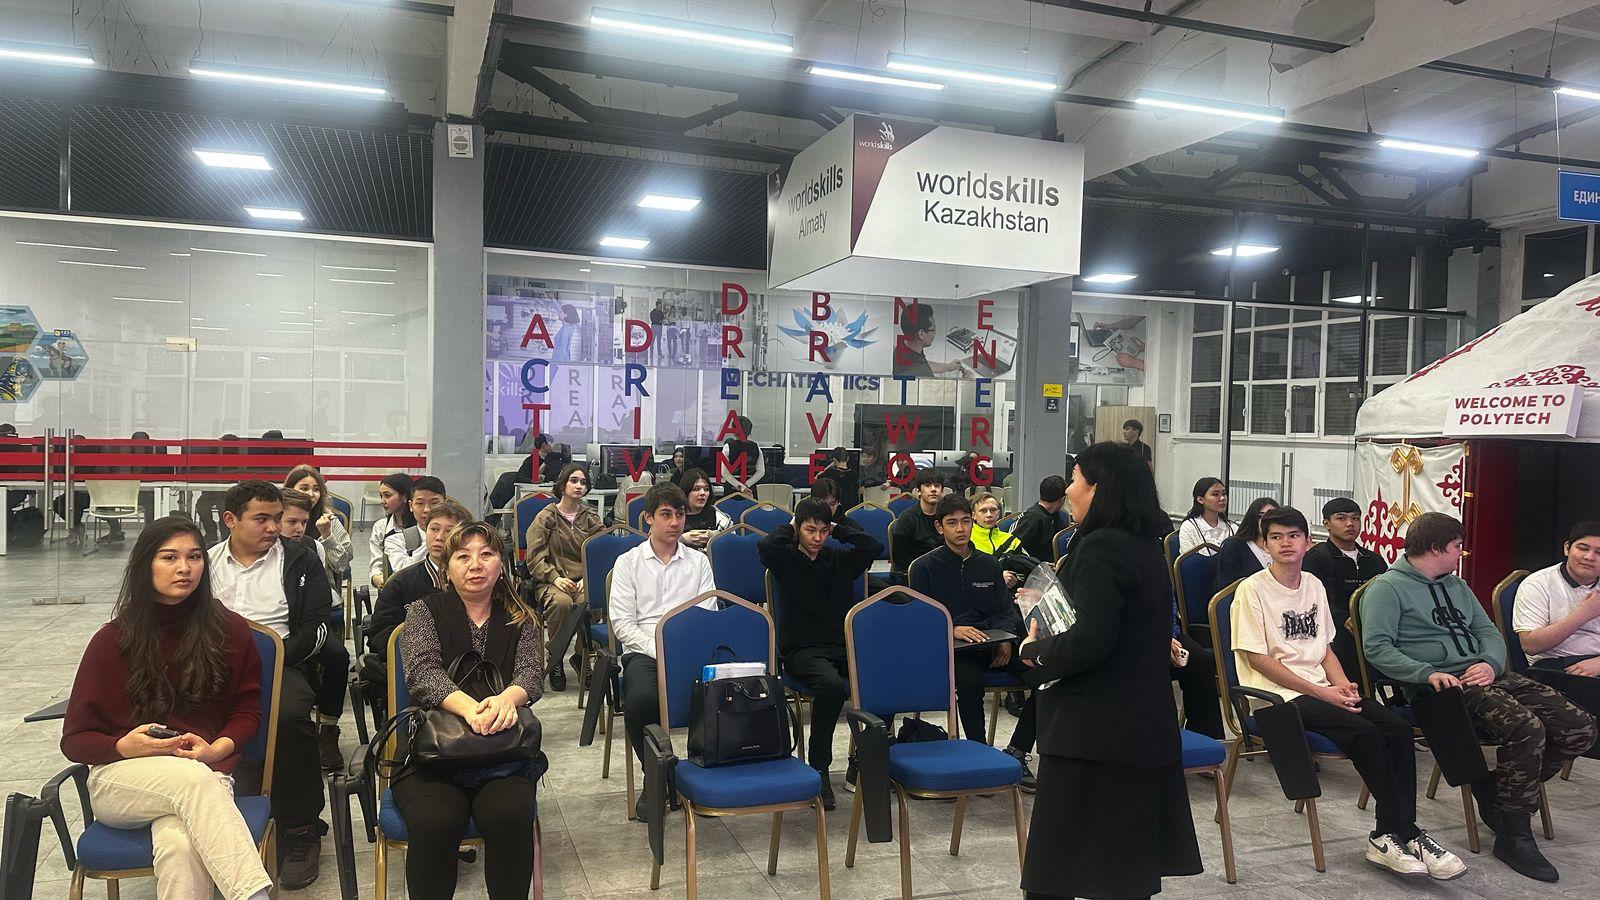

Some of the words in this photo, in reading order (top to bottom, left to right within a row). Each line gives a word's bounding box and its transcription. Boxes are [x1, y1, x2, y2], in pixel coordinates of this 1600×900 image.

[858, 140, 893, 150] worldskills
[788, 164, 843, 215] worldskills
[916, 170, 1060, 207] worldskills
[798, 209, 828, 240] Almaty
[924, 199, 1049, 234] Kazakhstan
[520, 313, 555, 500] ACTI
[621, 319, 654, 503] DRIV
[884, 296, 923, 499] NETWO
[969, 299, 998, 486] ENERG
[1454, 395, 1538, 409] WELCOME
[1542, 394, 1566, 407] TO
[1459, 412, 1552, 425] POLYTECH
